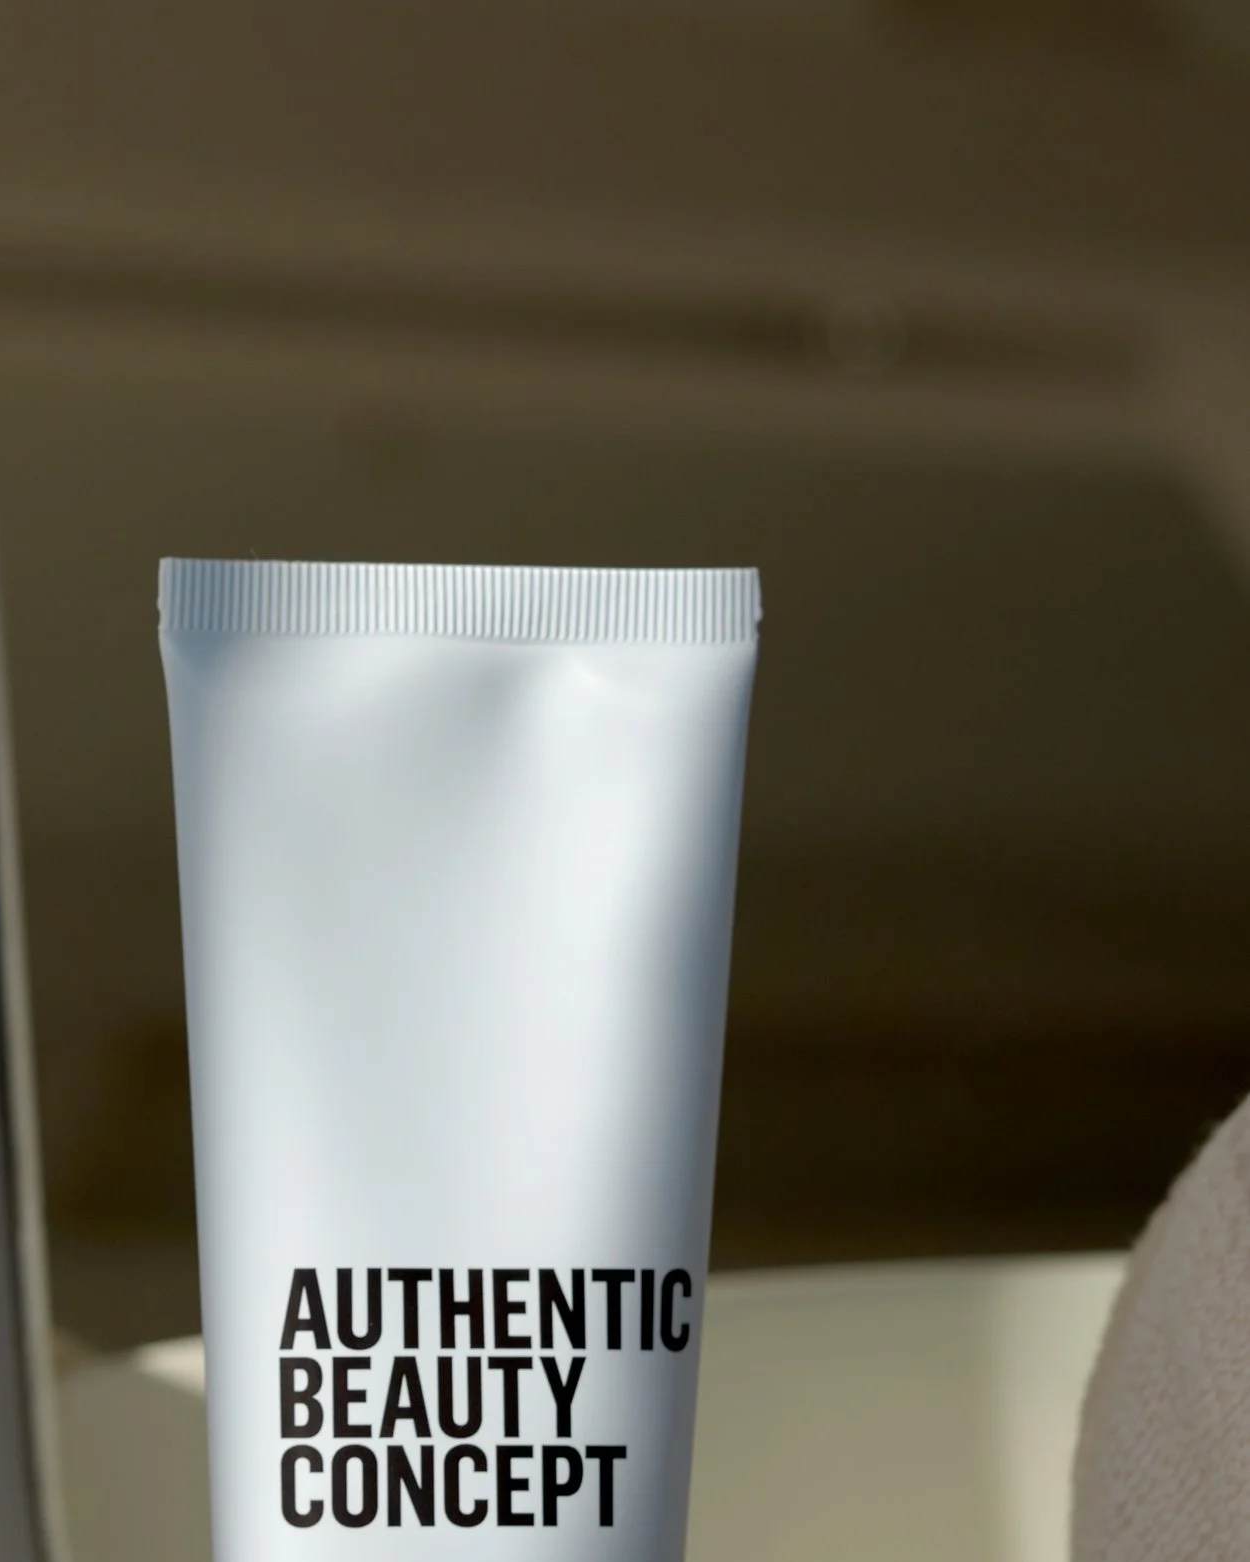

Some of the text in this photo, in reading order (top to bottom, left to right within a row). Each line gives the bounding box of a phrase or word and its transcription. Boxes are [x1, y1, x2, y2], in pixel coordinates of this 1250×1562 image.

[280, 1268, 691, 1352] AUTHENTIC
[280, 1356, 586, 1439] BEAUTY
[281, 1444, 626, 1528] CONCEPT
